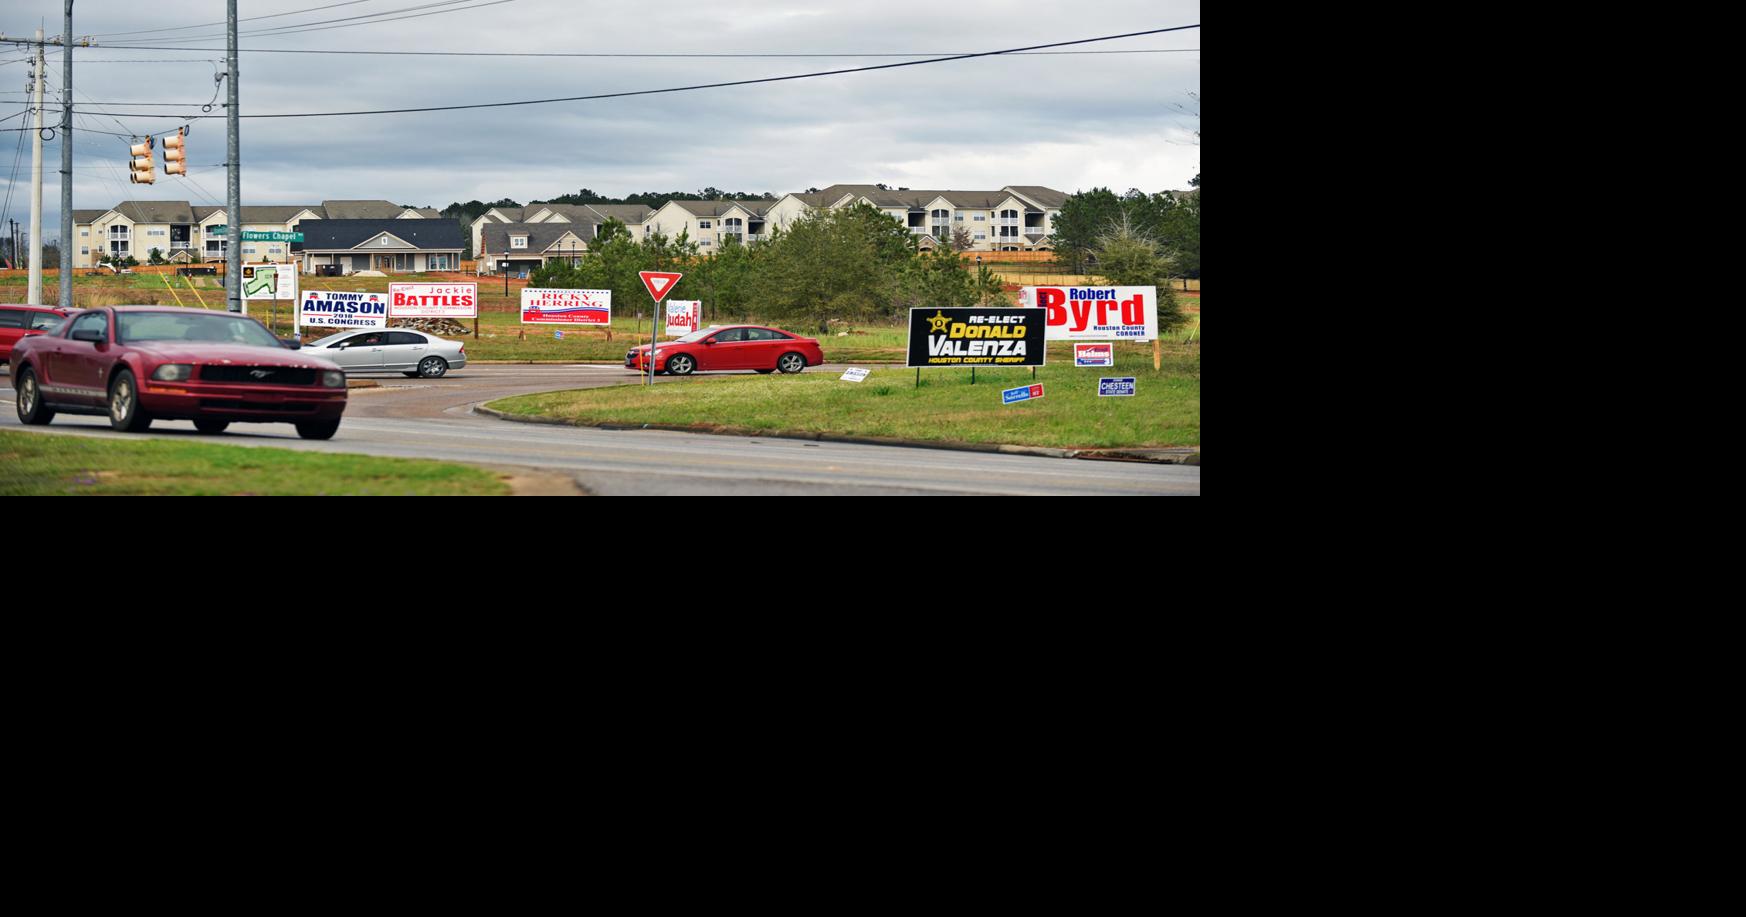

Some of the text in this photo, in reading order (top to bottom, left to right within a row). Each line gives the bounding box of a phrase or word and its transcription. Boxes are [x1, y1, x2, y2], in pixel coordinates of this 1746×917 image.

[242, 231, 270, 240] Flowers
[272, 232, 296, 241] Chapel
[326, 292, 364, 301] TOMMY
[1069, 288, 1116, 300] Robert
[303, 299, 385, 314] AMASON
[1036, 288, 1145, 332] Byrd
[327, 318, 376, 326] CONGRESS
[968, 315, 1026, 324] RE-ELECT
[1101, 382, 1133, 390] CHESTEEN
